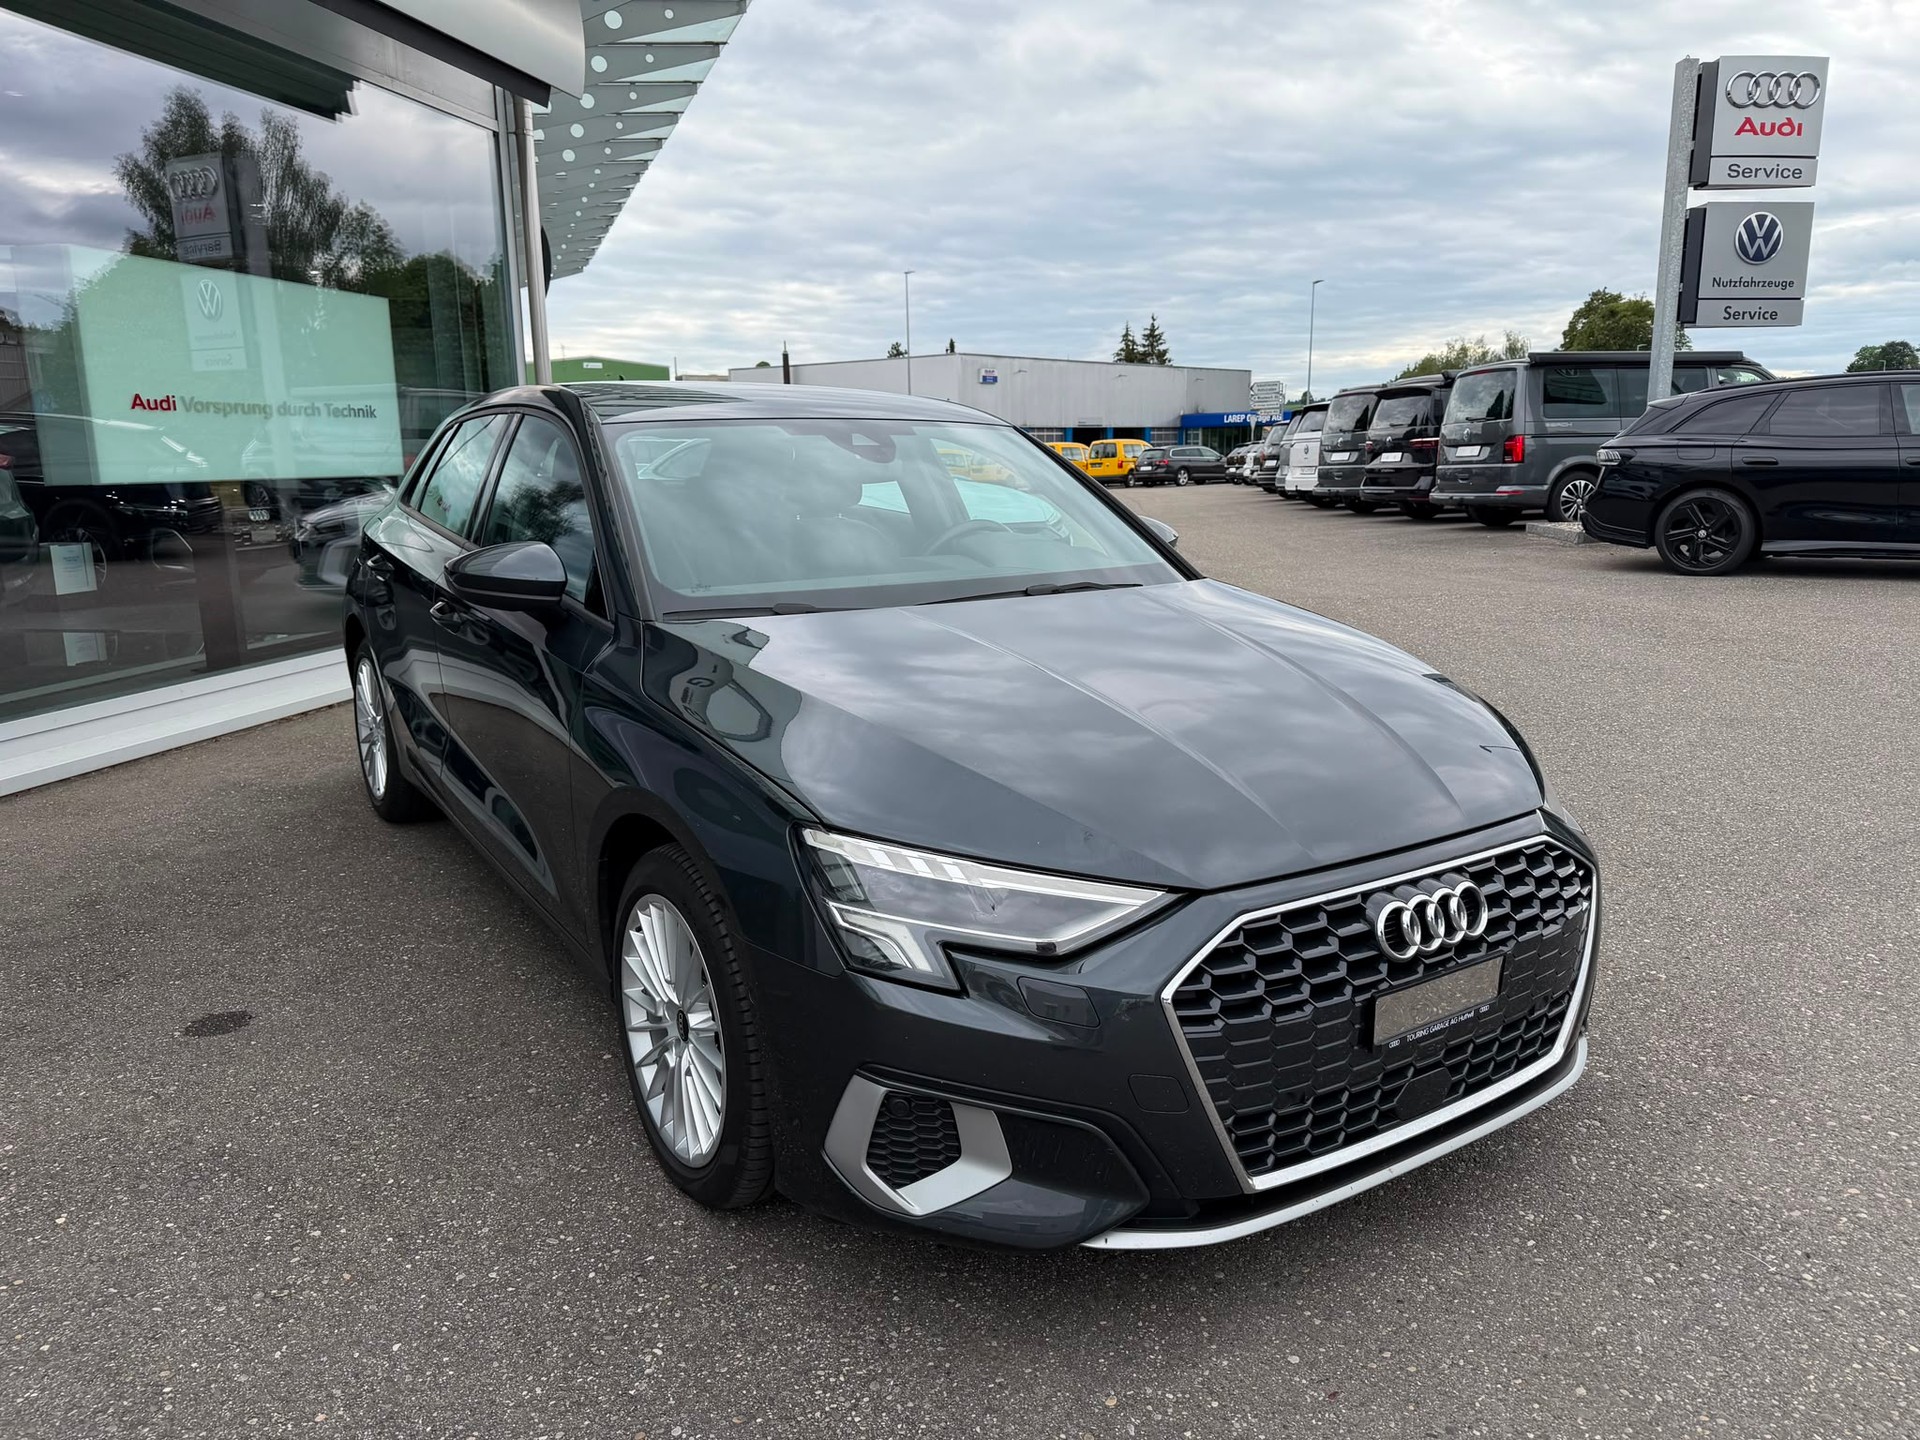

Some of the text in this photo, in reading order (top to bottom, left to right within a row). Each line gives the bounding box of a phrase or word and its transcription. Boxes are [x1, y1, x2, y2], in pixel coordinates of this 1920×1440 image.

[1734, 116, 1803, 137] Audi
[1727, 163, 1803, 179] Service
[1712, 276, 1795, 290] Nutzfahrzeuge
[1722, 305, 1778, 321] Service
[130, 393, 377, 420] Audi Vorsprung durch Technik
[1224, 414, 1245, 423] LAREP
[1246, 413, 1270, 424] Grage
[1406, 1027, 1429, 1042] TOURING
[1429, 1019, 1450, 1034] GARAGE
[1450, 1016, 1458, 1026] AG
